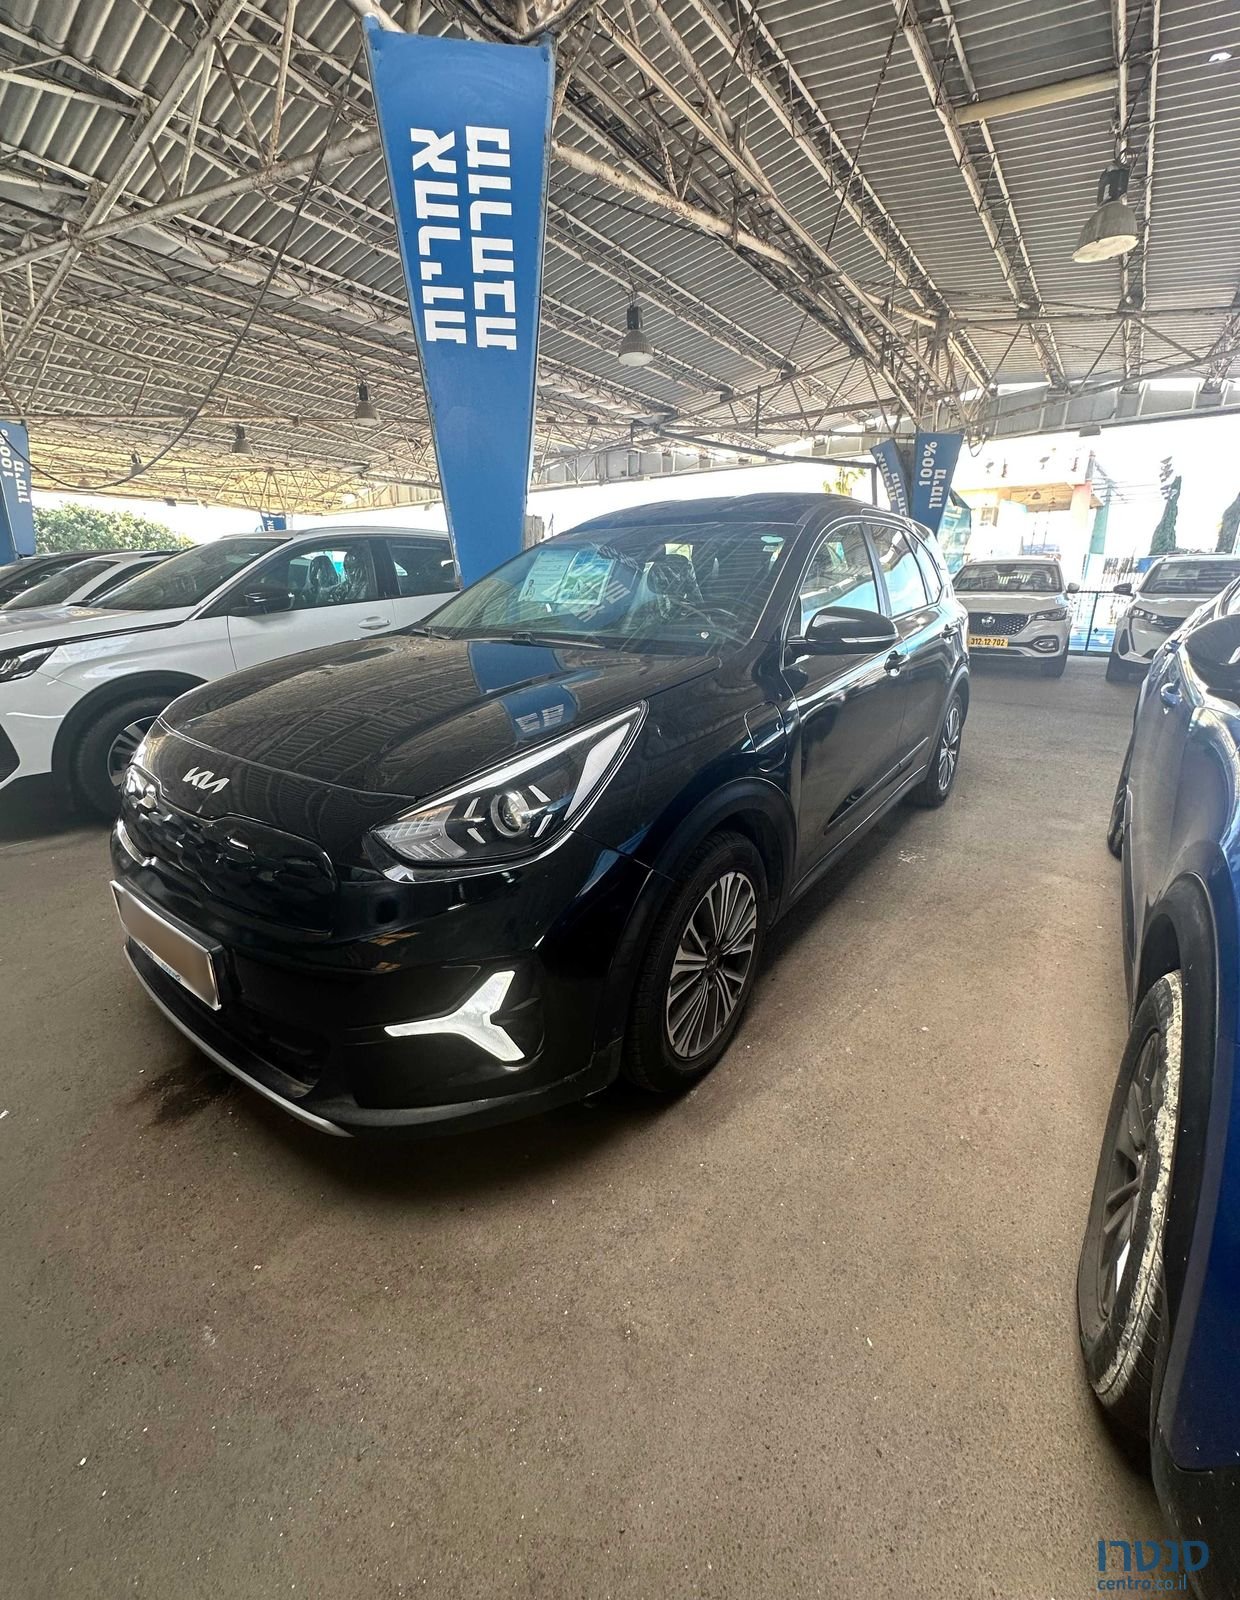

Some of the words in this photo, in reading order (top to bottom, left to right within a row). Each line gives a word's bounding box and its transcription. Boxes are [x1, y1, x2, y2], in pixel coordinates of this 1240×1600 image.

[410, 127, 467, 344] אחריות
[465, 125, 518, 351] מורחבת
[13, 460, 31, 503] מימון
[876, 451, 897, 502] אחריות
[918, 441, 938, 487] 100%
[891, 472, 908, 517] מורחב
[928, 469, 947, 509] מימון
